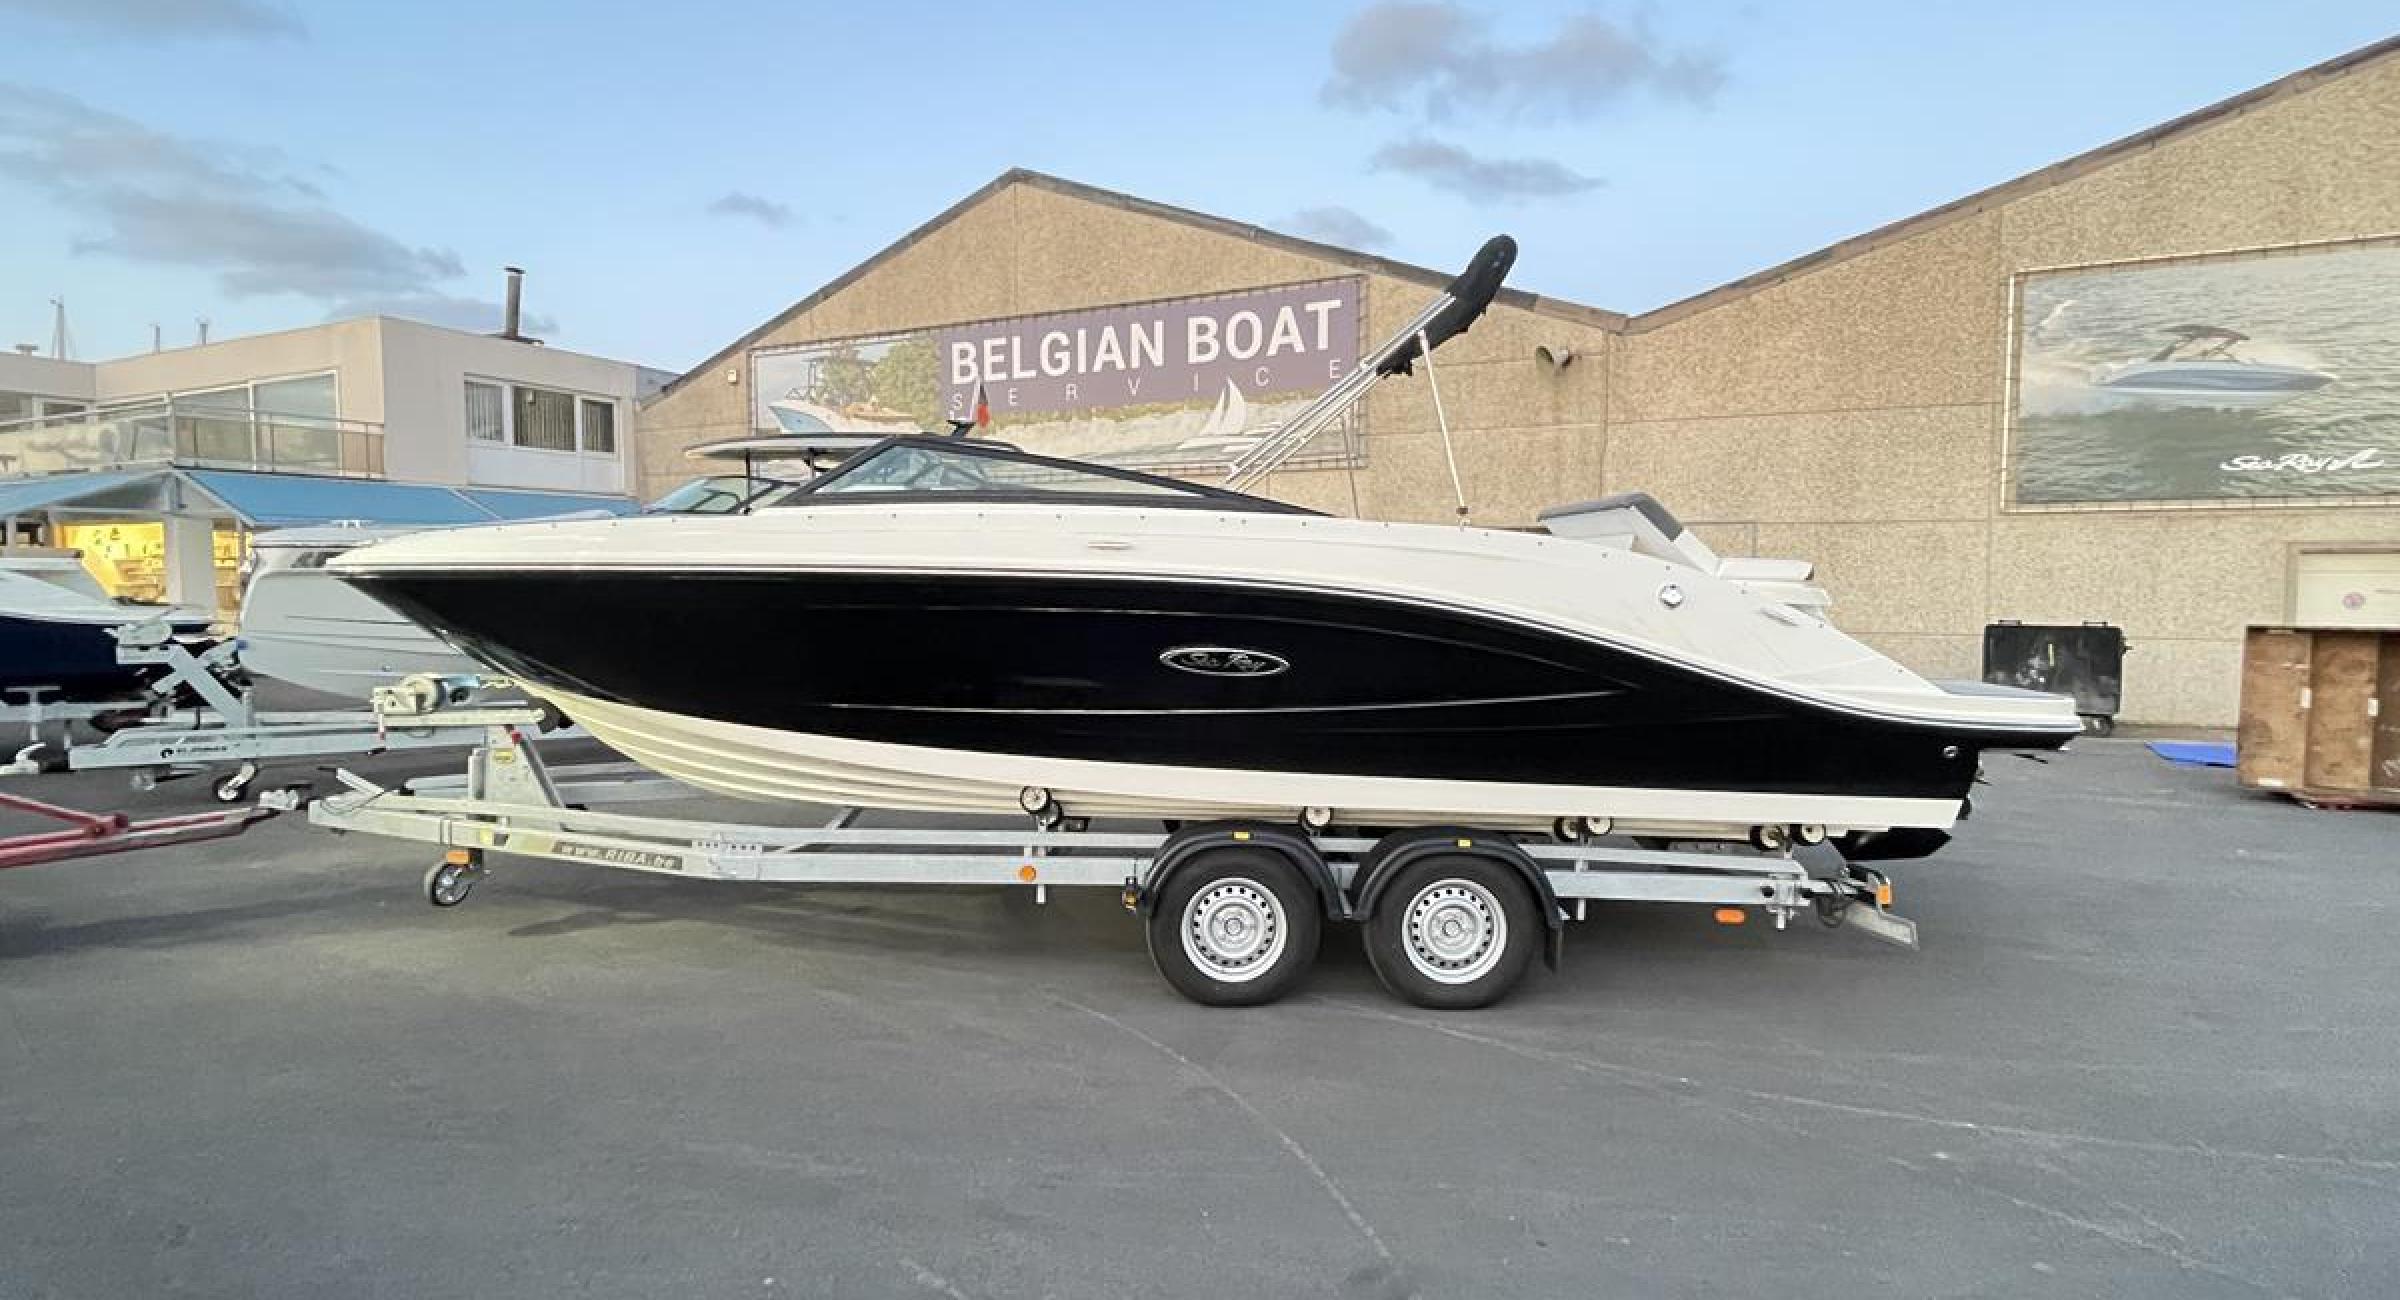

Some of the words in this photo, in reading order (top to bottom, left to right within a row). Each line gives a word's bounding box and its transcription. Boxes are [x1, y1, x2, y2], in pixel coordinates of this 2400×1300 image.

[950, 319, 1166, 386] BELGIAN
[1187, 299, 1342, 365] BOAT
[2219, 455, 2274, 471] Sea
[2273, 453, 2335, 473] Ray
[1180, 653, 1222, 668] Sea
[1223, 653, 1267, 673] Ray
